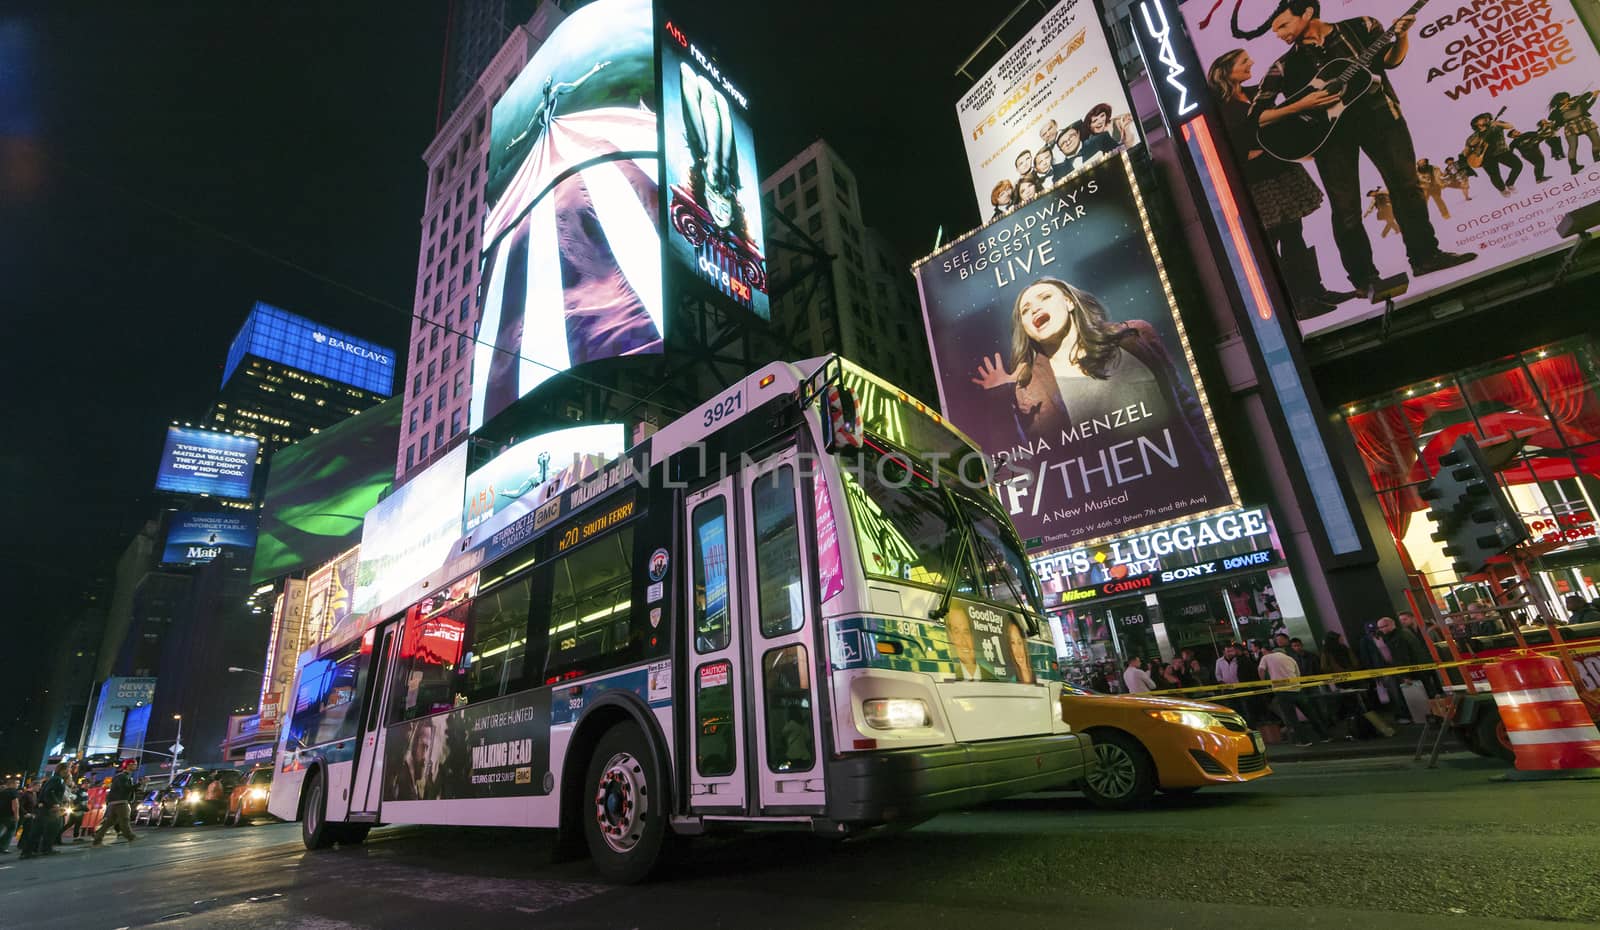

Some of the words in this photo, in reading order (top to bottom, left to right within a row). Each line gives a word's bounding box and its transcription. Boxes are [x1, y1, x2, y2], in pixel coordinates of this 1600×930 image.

[1445, 0, 1550, 55] OLIVIER
[998, 36, 1033, 70] MATTHEW
[1426, 8, 1553, 84] ACADEMY
[1444, 35, 1570, 101] WINNING
[1488, 48, 1576, 98] MUSIC
[973, 113, 997, 141] IT'S
[997, 82, 1031, 117] ONLY
[1034, 73, 1045, 87] A
[1046, 31, 1086, 75] PLAY
[943, 250, 971, 273] SEE
[978, 180, 1099, 254] BROADWAY'S
[959, 235, 1032, 280] BIGGEST
[1041, 204, 1087, 237] STAR
[699, 256, 720, 281] OCT
[721, 268, 730, 287] 8
[994, 240, 1056, 288] LIVE
[328, 337, 388, 364] BARCLAYS
[703, 390, 742, 428] 3921
[1061, 401, 1153, 446] MENZEL
[172, 450, 206, 460] MATILDA
[206, 454, 224, 462] WAS
[172, 463, 199, 472] KNOW
[176, 456, 197, 465] THEY
[197, 459, 216, 467] JUST
[582, 517, 607, 539] SOUTH
[608, 502, 634, 527] FERRY
[1042, 513, 1052, 525] A
[1054, 505, 1081, 523] New
[1084, 490, 1129, 512] Musical
[1071, 526, 1086, 536] 226
[1086, 523, 1096, 533] W
[1113, 517, 1122, 527] St
[1142, 507, 1157, 519] 7th
[1157, 504, 1174, 515] and
[1175, 500, 1188, 510] 8th
[1110, 510, 1269, 565] LUGGAGE
[1061, 588, 1097, 603] Nikon
[1103, 575, 1153, 595] Canon
[1161, 562, 1217, 583] SONY
[1223, 551, 1270, 571] BOWER
[968, 606, 990, 621] Good
[989, 611, 1004, 627] Day
[973, 620, 988, 632] New
[988, 623, 1003, 634] York
[1119, 613, 1144, 626] 1550
[982, 636, 1007, 665] #1
[700, 663, 727, 676] CAUTION
[117, 690, 137, 699] OCT
[568, 697, 584, 710] 3921
[471, 743, 509, 769] WALKING
[506, 738, 534, 765] DEAD
